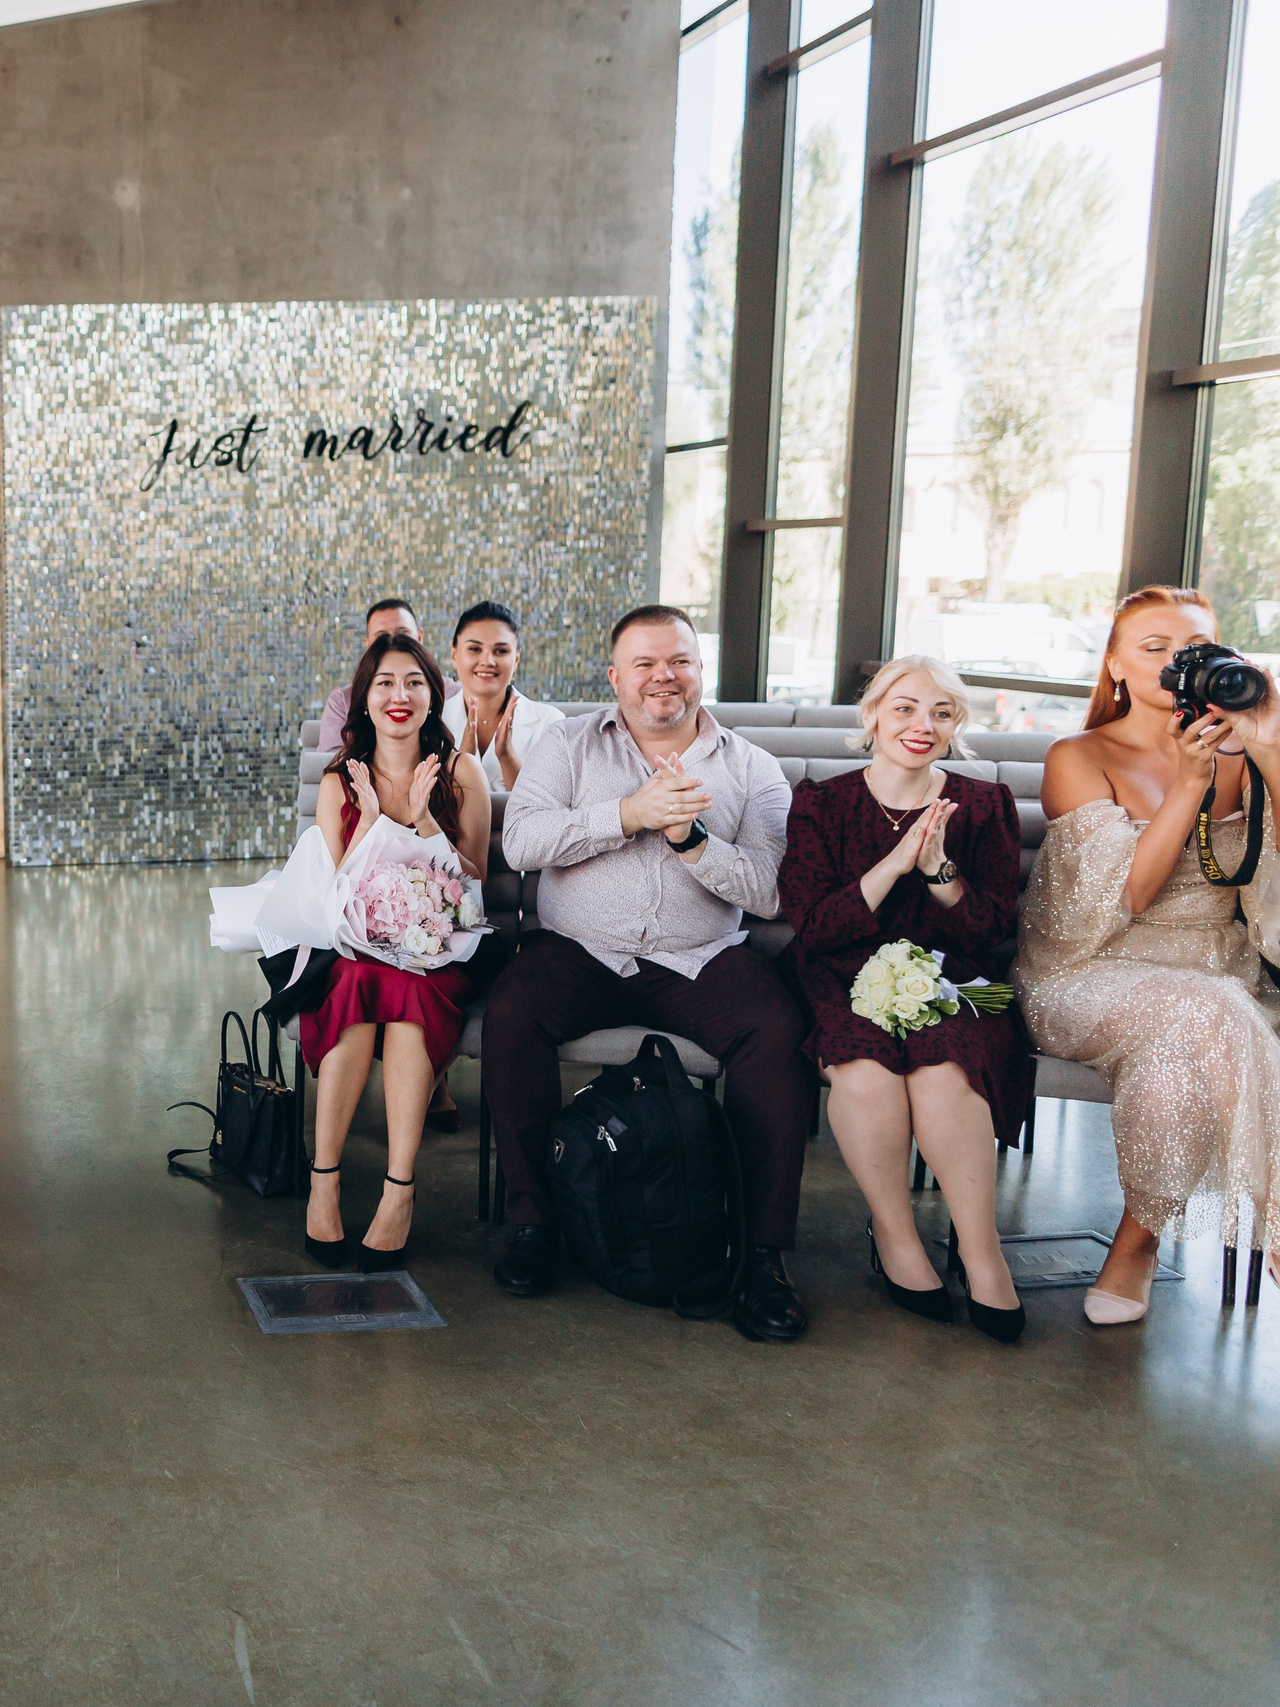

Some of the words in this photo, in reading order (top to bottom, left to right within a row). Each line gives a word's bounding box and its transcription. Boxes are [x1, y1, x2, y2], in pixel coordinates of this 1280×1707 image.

[139, 413, 268, 492] Just
[302, 400, 535, 462] married
[1198, 812, 1209, 847] Nikon
[1200, 848, 1222, 880] D750
